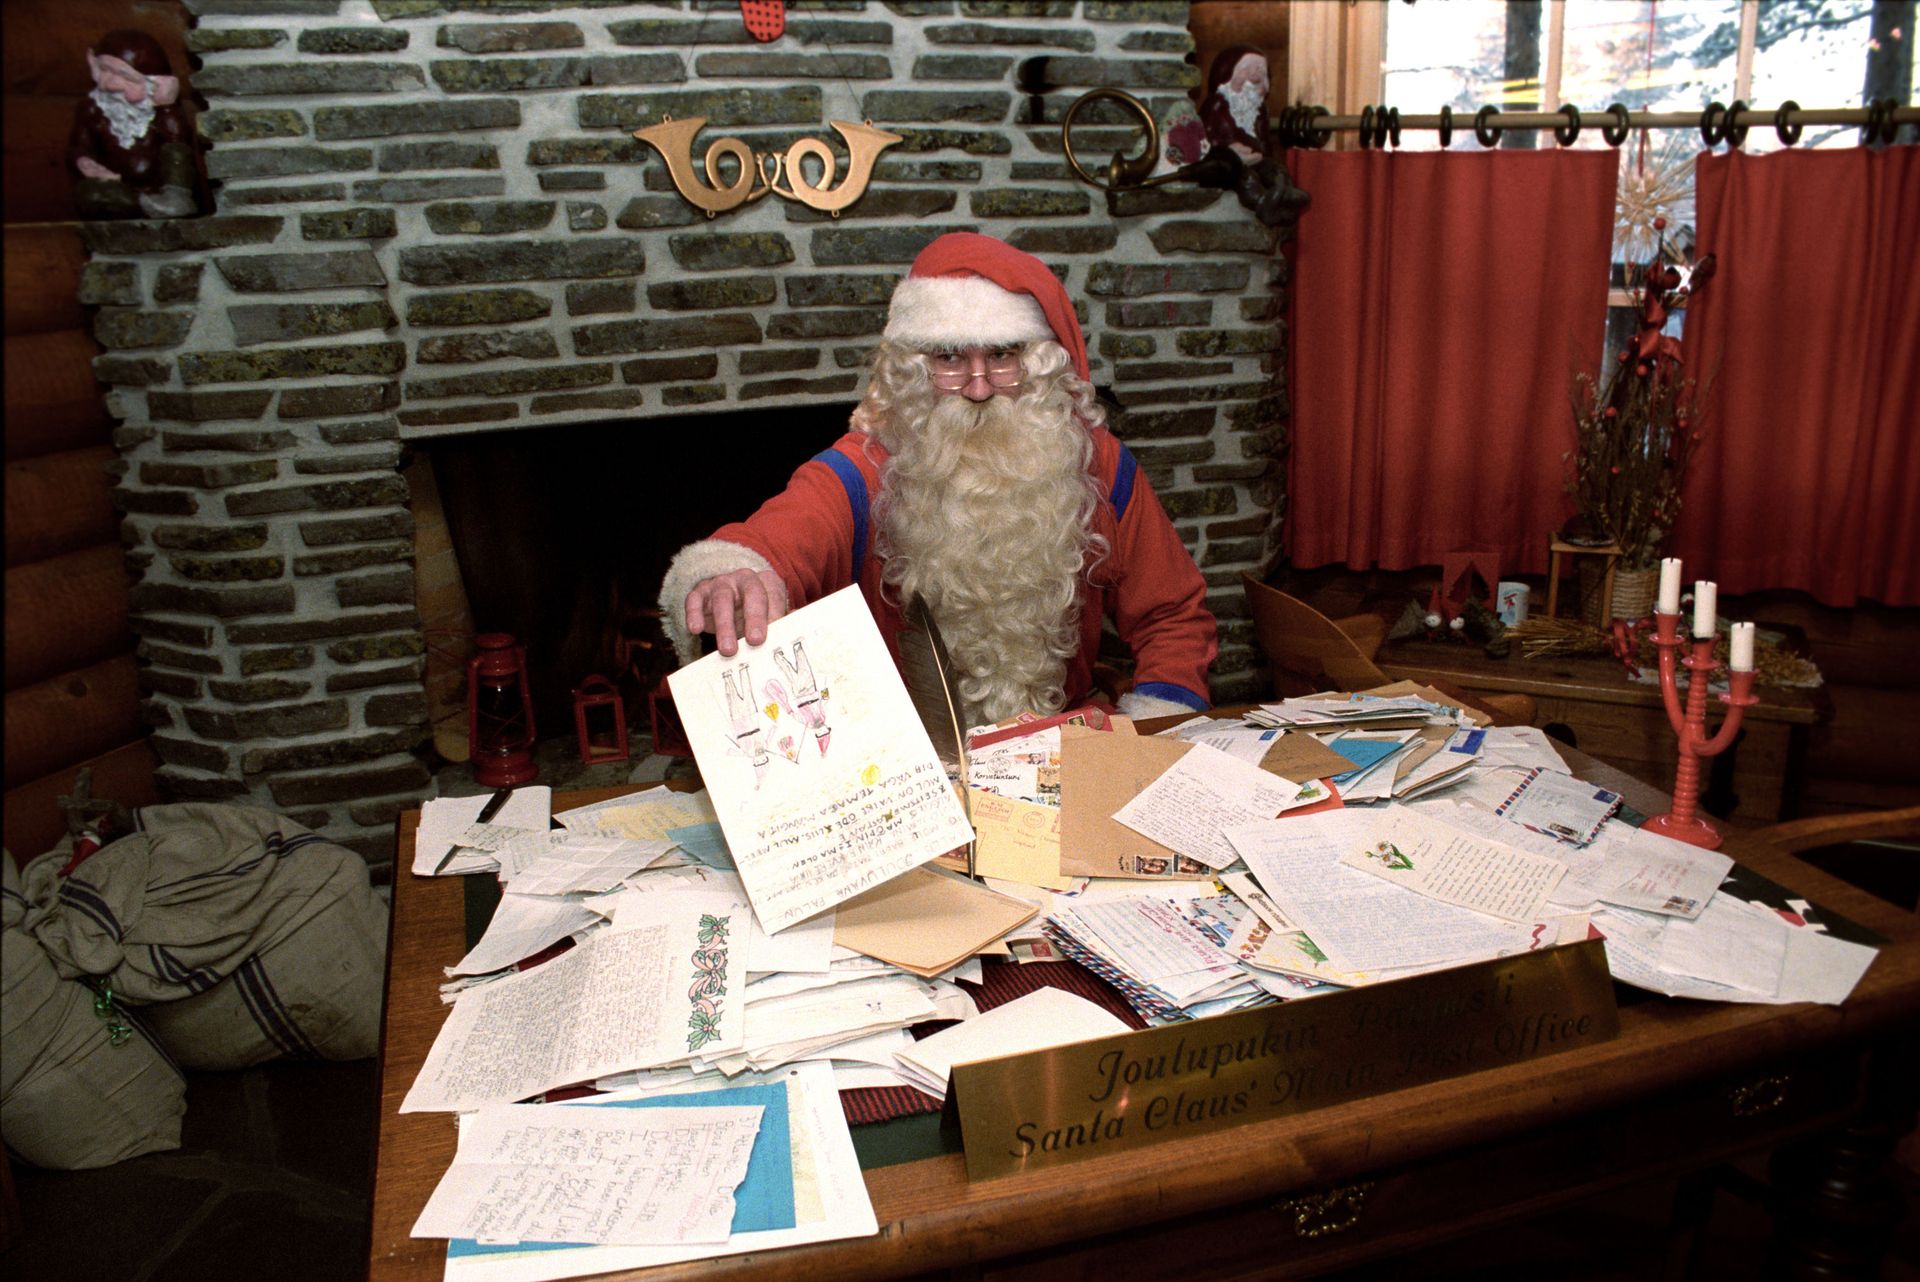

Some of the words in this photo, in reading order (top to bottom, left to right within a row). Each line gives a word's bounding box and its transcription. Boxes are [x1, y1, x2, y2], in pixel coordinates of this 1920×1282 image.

[1009, 1109, 1125, 1158] Santa
[1144, 1080, 1257, 1130] Claus'
[1269, 1062, 1375, 1105] Main
[1394, 1040, 1478, 1079] Post
[1492, 1013, 1591, 1058] Office
[1089, 1023, 1317, 1103] Joulupukin
[644, 1129, 668, 1157] Dear
